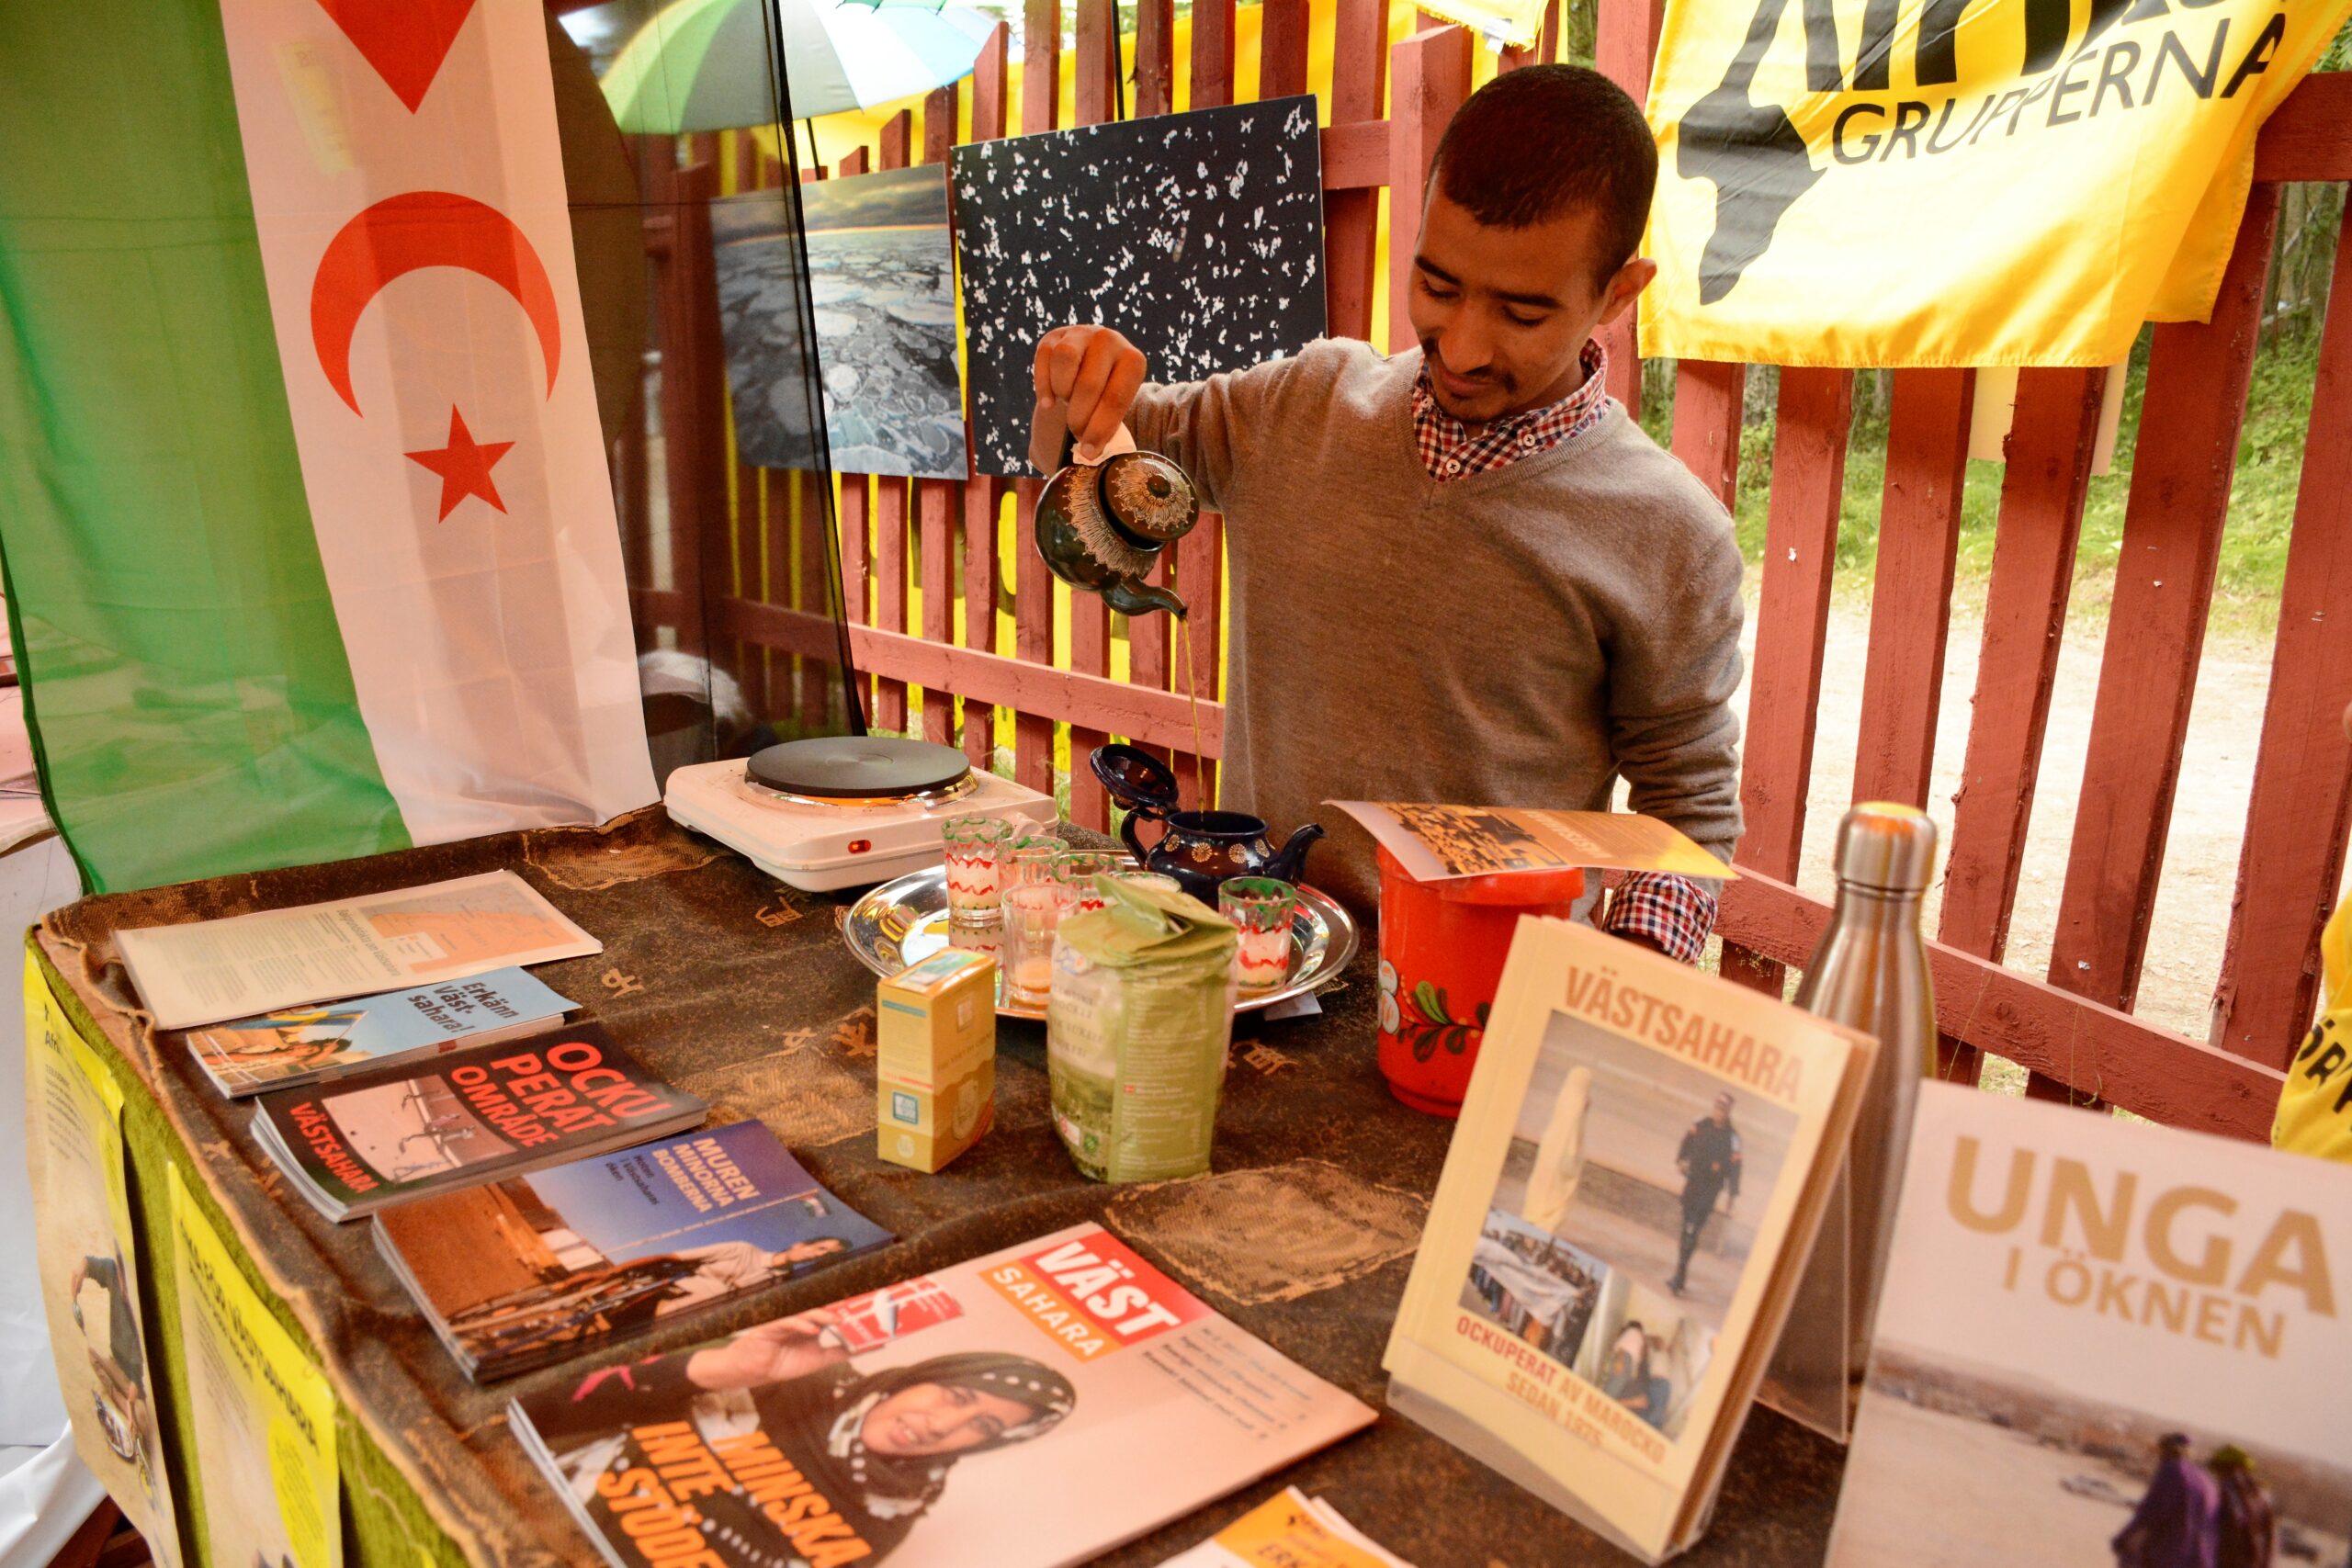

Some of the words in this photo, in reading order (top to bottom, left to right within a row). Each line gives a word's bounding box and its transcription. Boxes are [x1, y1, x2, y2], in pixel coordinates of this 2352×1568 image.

[1832, 13, 2286, 164] GRUPPERNA
[408, 995, 476, 1032] sahara!
[434, 985, 476, 1014] Väst-
[462, 982, 519, 1019] Erkänn
[1566, 965, 1805, 1102] VÄSTSAHARA
[451, 1066, 558, 1148] OMRÅDE
[491, 1053, 617, 1134] PERAT
[548, 1042, 673, 1119] OCKU
[289, 1103, 379, 1194] VÄSTSAHARA
[652, 1148, 713, 1213] BOMBERNA
[673, 1143, 734, 1208] MINORNA
[692, 1137, 761, 1201] MUREN
[1945, 1135, 2336, 1320] UNGA
[992, 1267, 1104, 1357] SAHARA
[1035, 1241, 1182, 1337] VÄST
[2003, 1247, 2022, 1292] I
[2046, 1248, 2289, 1360] ÖKNEN
[1456, 1315, 1558, 1384] OCKUPERAT
[1558, 1375, 1581, 1404] AV
[1583, 1393, 1667, 1465] MAROCKO
[1506, 1371, 1562, 1421] SEDAN
[632, 1420, 736, 1501] INTE
[709, 1430, 872, 1568] MINSKA
[596, 1467, 729, 1568] STÖD
